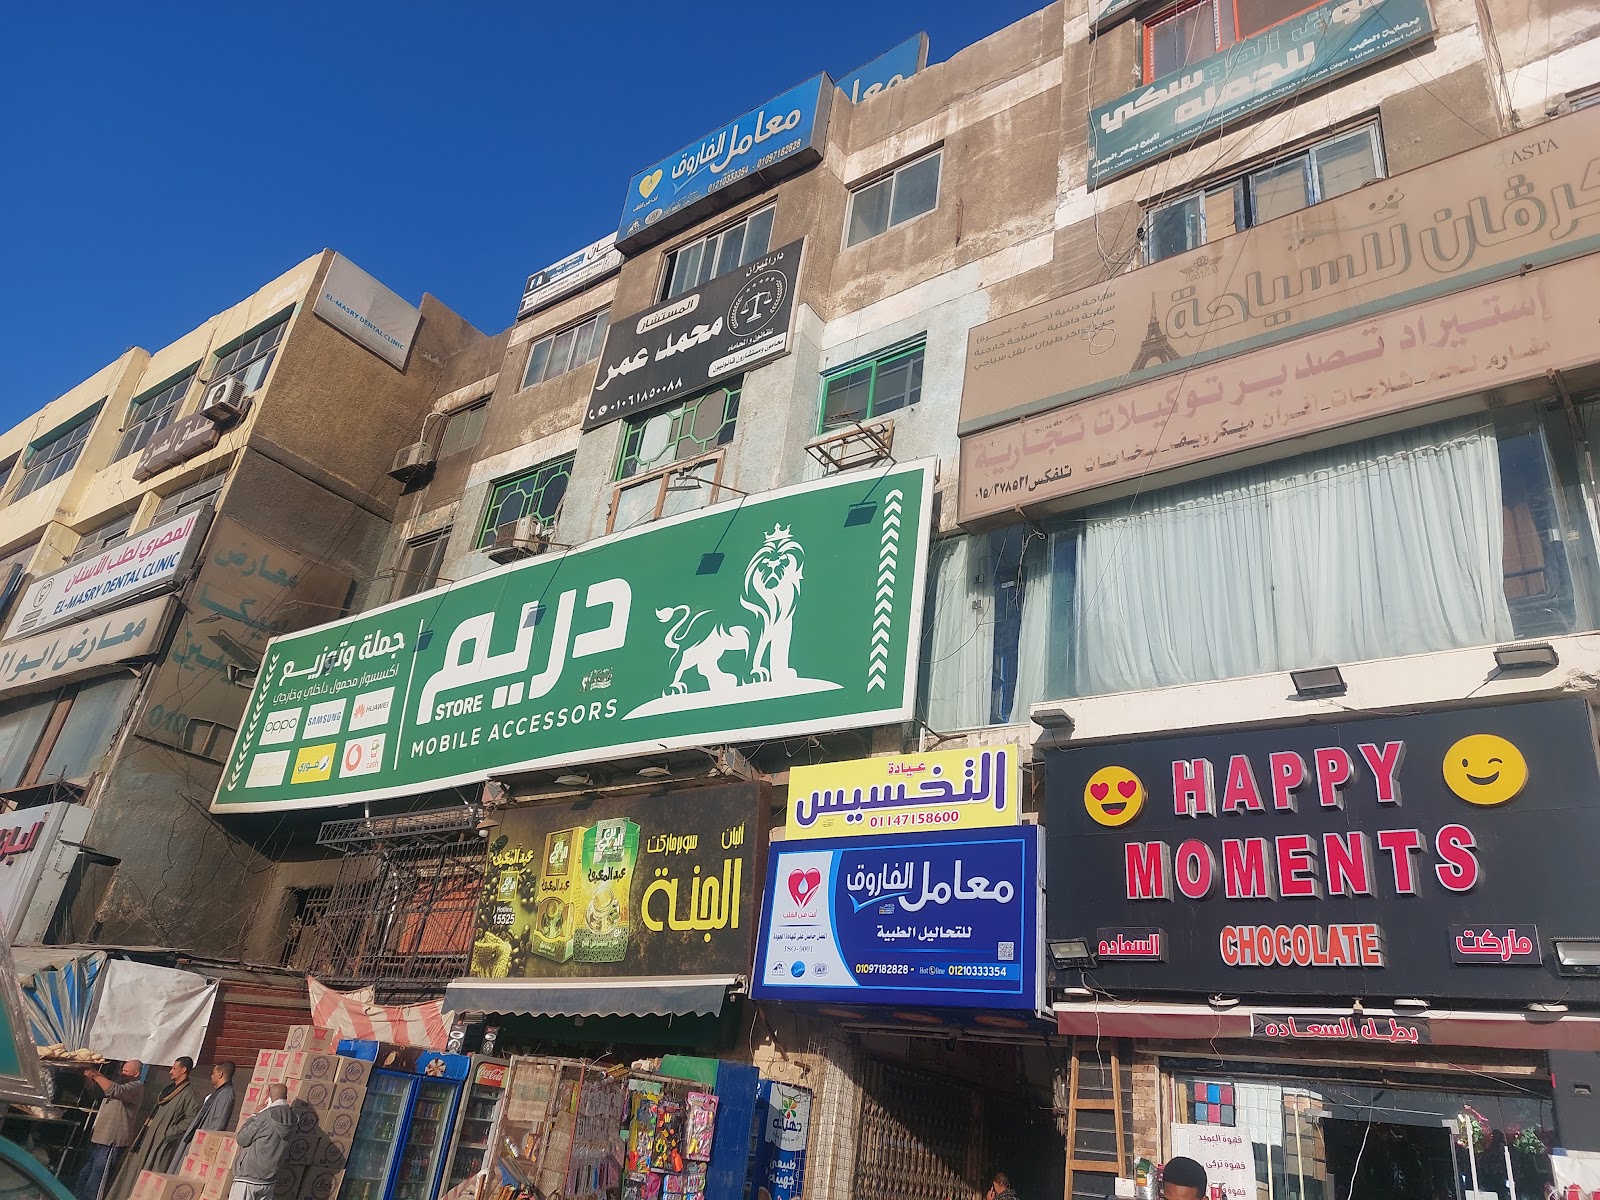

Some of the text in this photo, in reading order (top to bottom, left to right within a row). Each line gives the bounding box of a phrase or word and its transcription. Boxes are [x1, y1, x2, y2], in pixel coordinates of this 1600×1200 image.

[671, 109, 801, 179] معامل الفاروق
[1511, 138, 1559, 165] ASTA
[746, 256, 771, 277] الميزان
[1166, 222, 1409, 339] للسياحة
[325, 293, 404, 350] EL-MASRY DENTAL CLINIC
[640, 299, 694, 332] المستشار
[1047, 317, 1080, 332] داخلية
[595, 315, 723, 391] محمد عمر
[974, 341, 1005, 357] خارجية
[1007, 331, 1038, 346] سياحة
[1229, 319, 1385, 407] تصدير
[1092, 375, 1224, 437] توكيلات
[974, 411, 1086, 476] تجارية
[139, 516, 195, 562] المصري
[107, 540, 143, 574] لطب
[53, 552, 180, 615] EL-MASRY DENTAL CLINIC
[52, 617, 147, 671] معارض
[358, 629, 406, 660] جملة
[416, 577, 632, 726] دريم
[278, 640, 356, 686] وتوزيع
[358, 663, 400, 689] اكسسوار
[329, 677, 359, 695] محمول
[307, 711, 342, 726] SAMSUNG
[365, 701, 390, 713] HUAWEI
[434, 694, 484, 721] STORE
[265, 717, 297, 734] oppo
[410, 698, 618, 759] MOBILE ACCESSORS
[888, 761, 926, 776] عيادة
[1171, 740, 1404, 818] HAPPY
[795, 751, 1006, 826] التخسيس
[869, 811, 960, 828] 01147158600
[521, 849, 534, 867] عبد
[647, 833, 699, 856] سوبرماركت
[614, 867, 627, 883] عبد
[1124, 823, 1482, 901] MOMENTS
[641, 858, 743, 943] الجنة
[846, 860, 1015, 912] معامل الفاروق
[493, 913, 515, 925] 15525
[876, 924, 972, 942] للتحاليل الطبية
[1097, 928, 1533, 962] ماركت السعاده
[1220, 922, 1384, 968] CHOCOLATE
[855, 963, 909, 975] 01097182828
[948, 965, 1006, 977] 01210333354
[1265, 1015, 1358, 1038] السعاده
